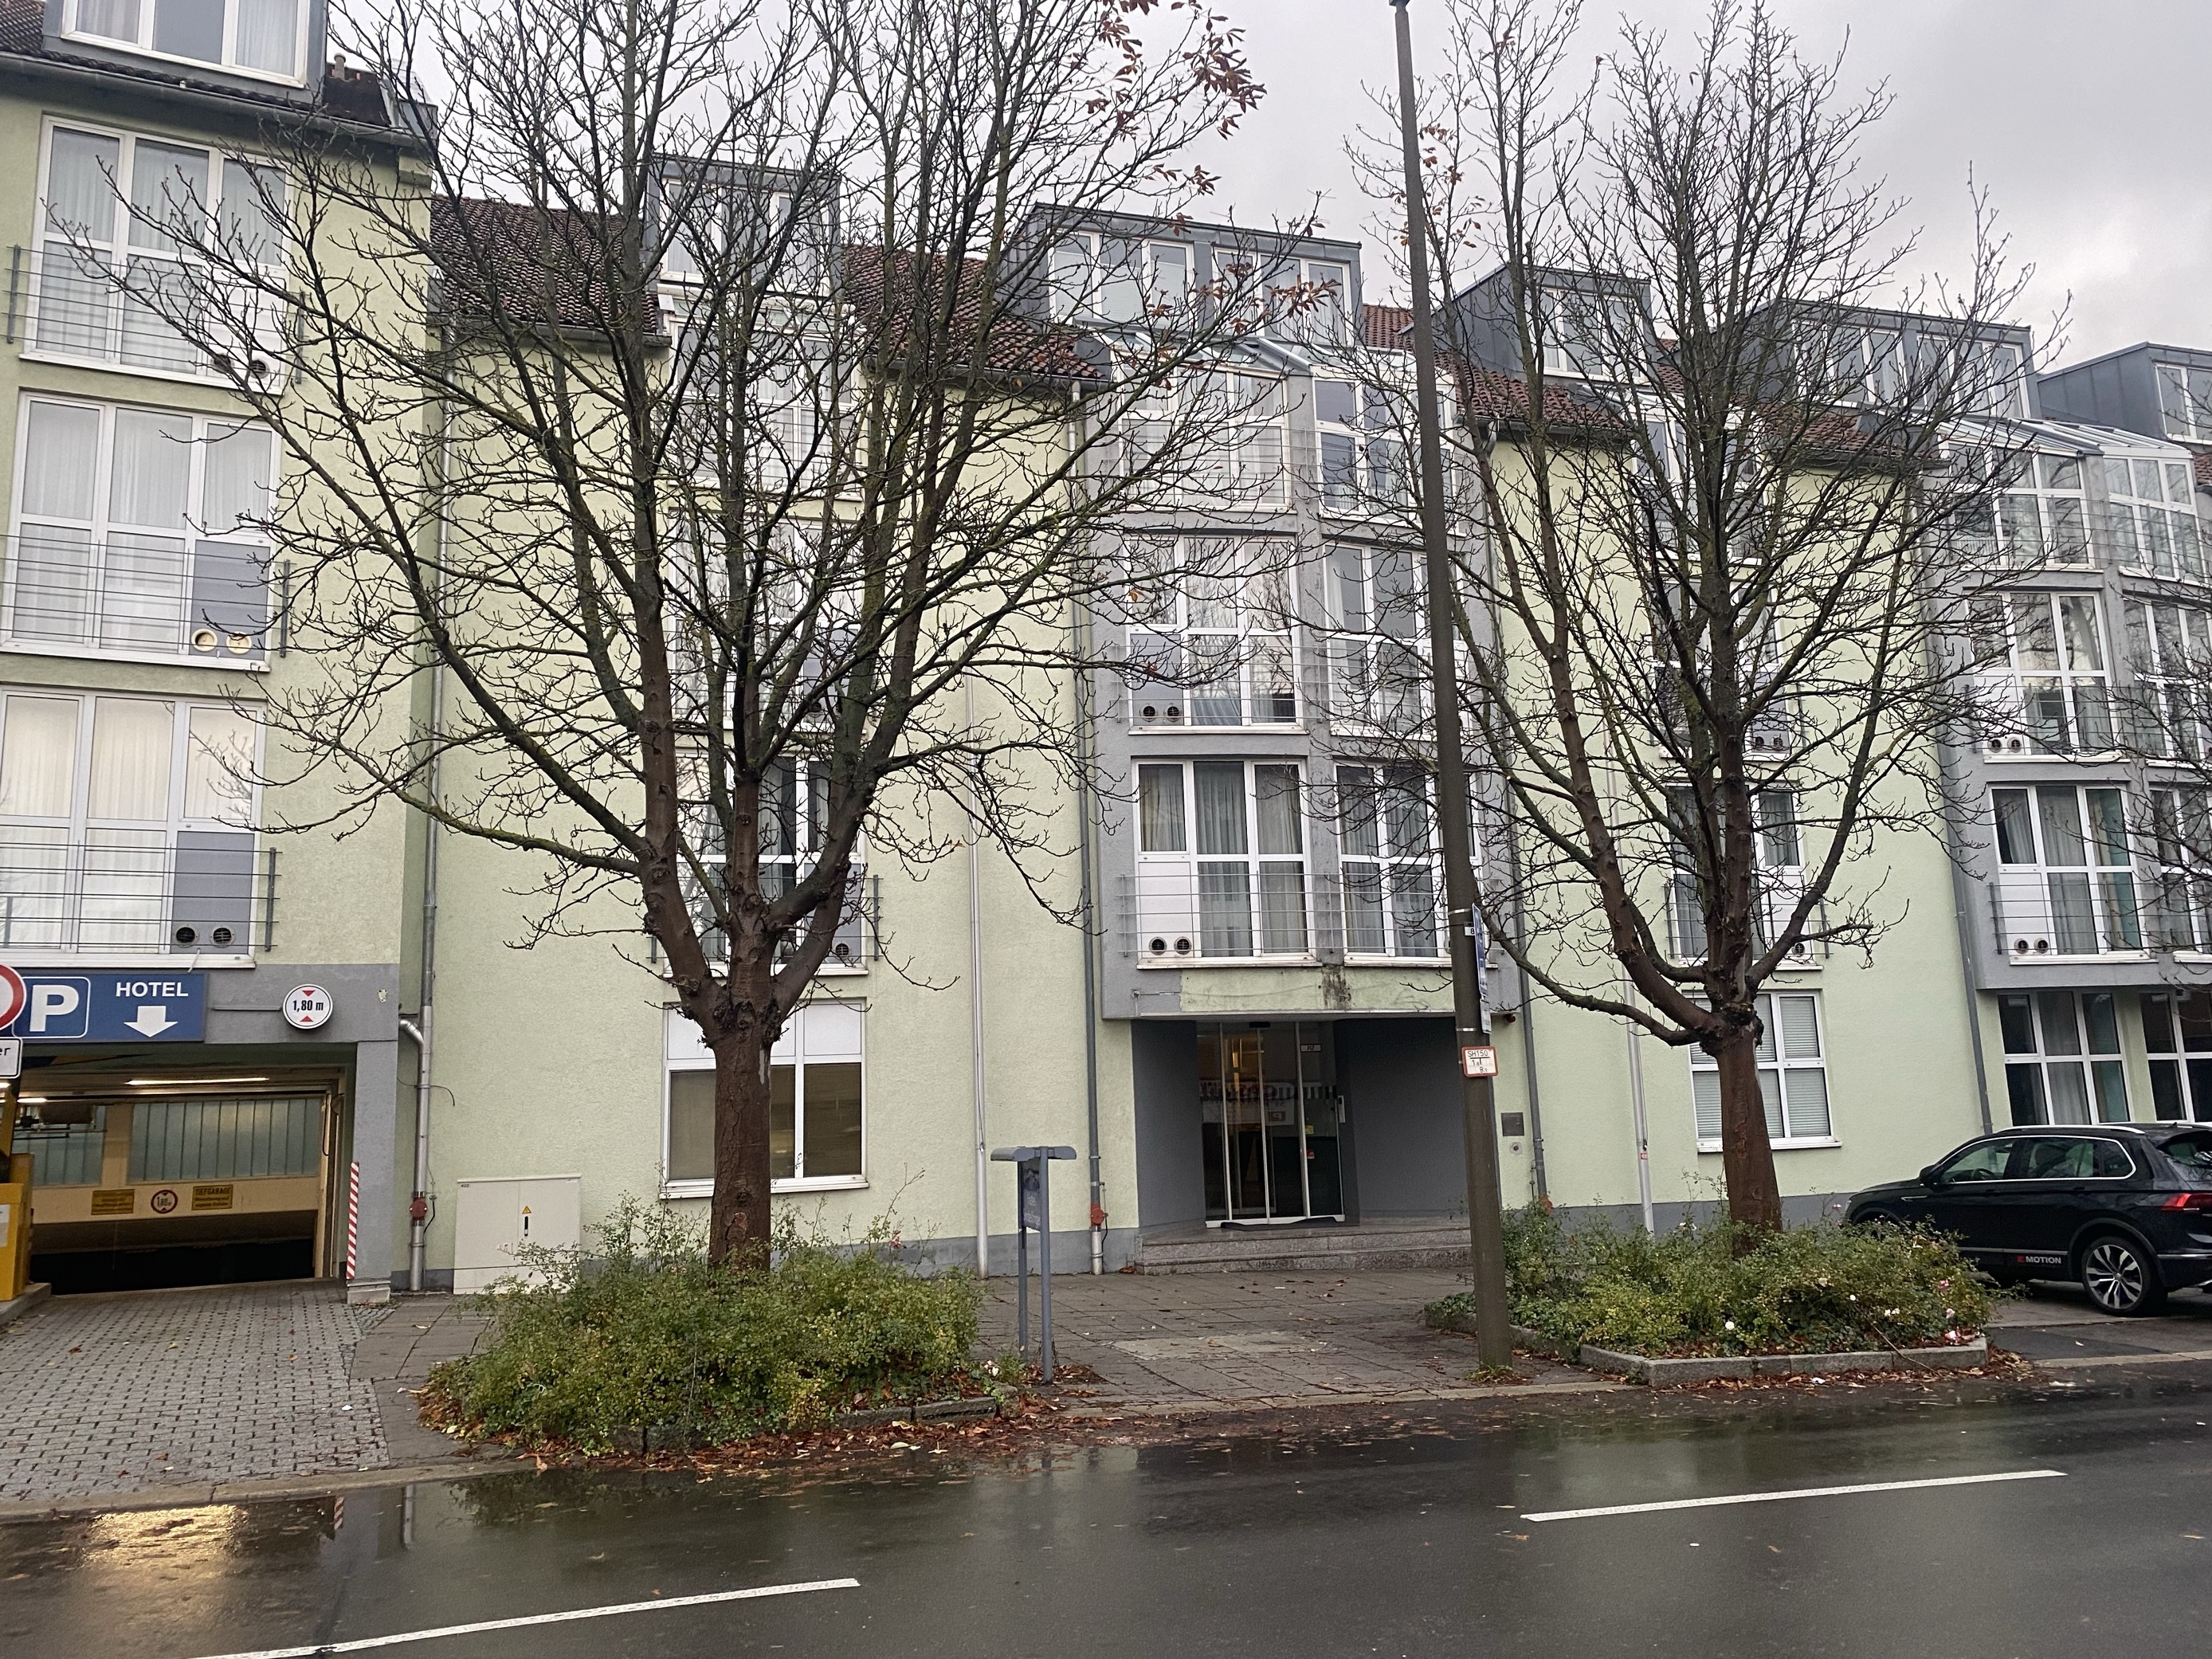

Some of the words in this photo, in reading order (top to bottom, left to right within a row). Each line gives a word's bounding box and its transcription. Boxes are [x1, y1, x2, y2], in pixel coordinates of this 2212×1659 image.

[116, 982, 189, 997] HOTEL
[29, 985, 79, 1032] P
[292, 999, 313, 1012] 1,80
[316, 1002, 324, 1011] m
